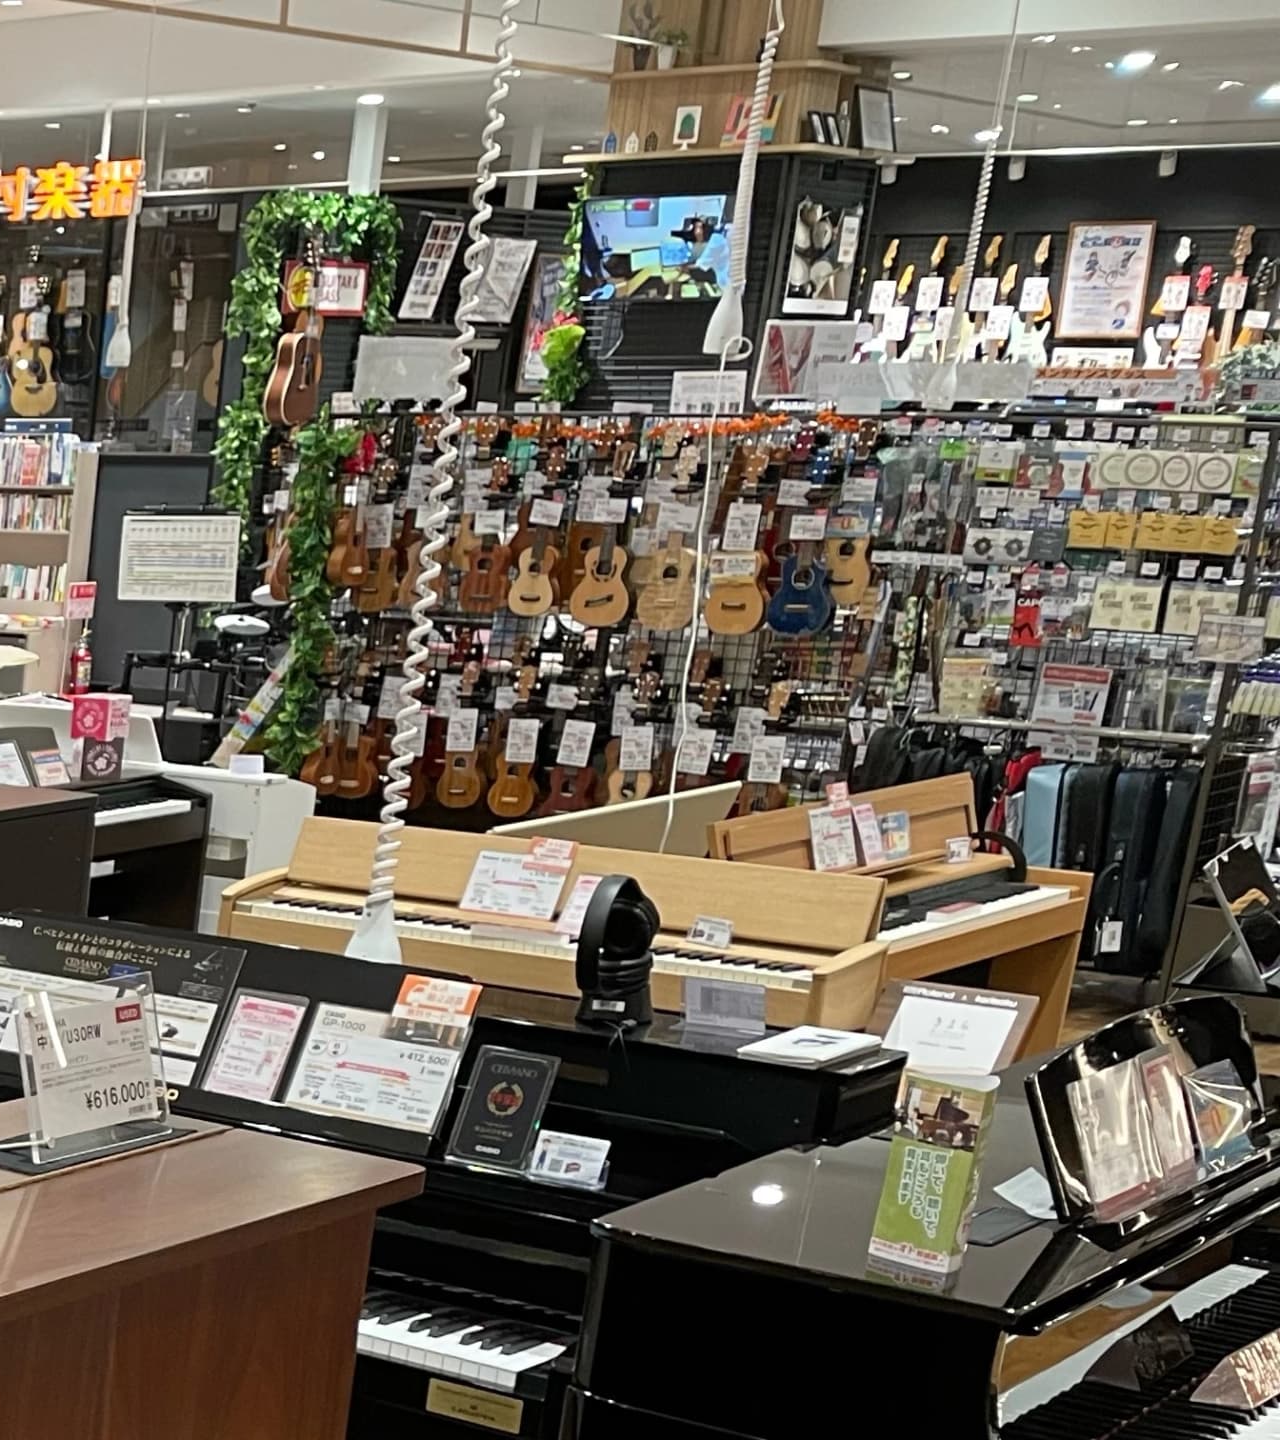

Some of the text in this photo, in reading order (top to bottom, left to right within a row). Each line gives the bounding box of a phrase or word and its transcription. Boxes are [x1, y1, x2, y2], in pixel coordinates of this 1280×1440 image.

[1036, 367, 1147, 379] メンテナンスグッズ
[118, 1007, 138, 1020] USED
[322, 1017, 366, 1032] GP-1000
[37, 1024, 102, 1051] 中/U30RW
[84, 1080, 146, 1111] ¥616,000
